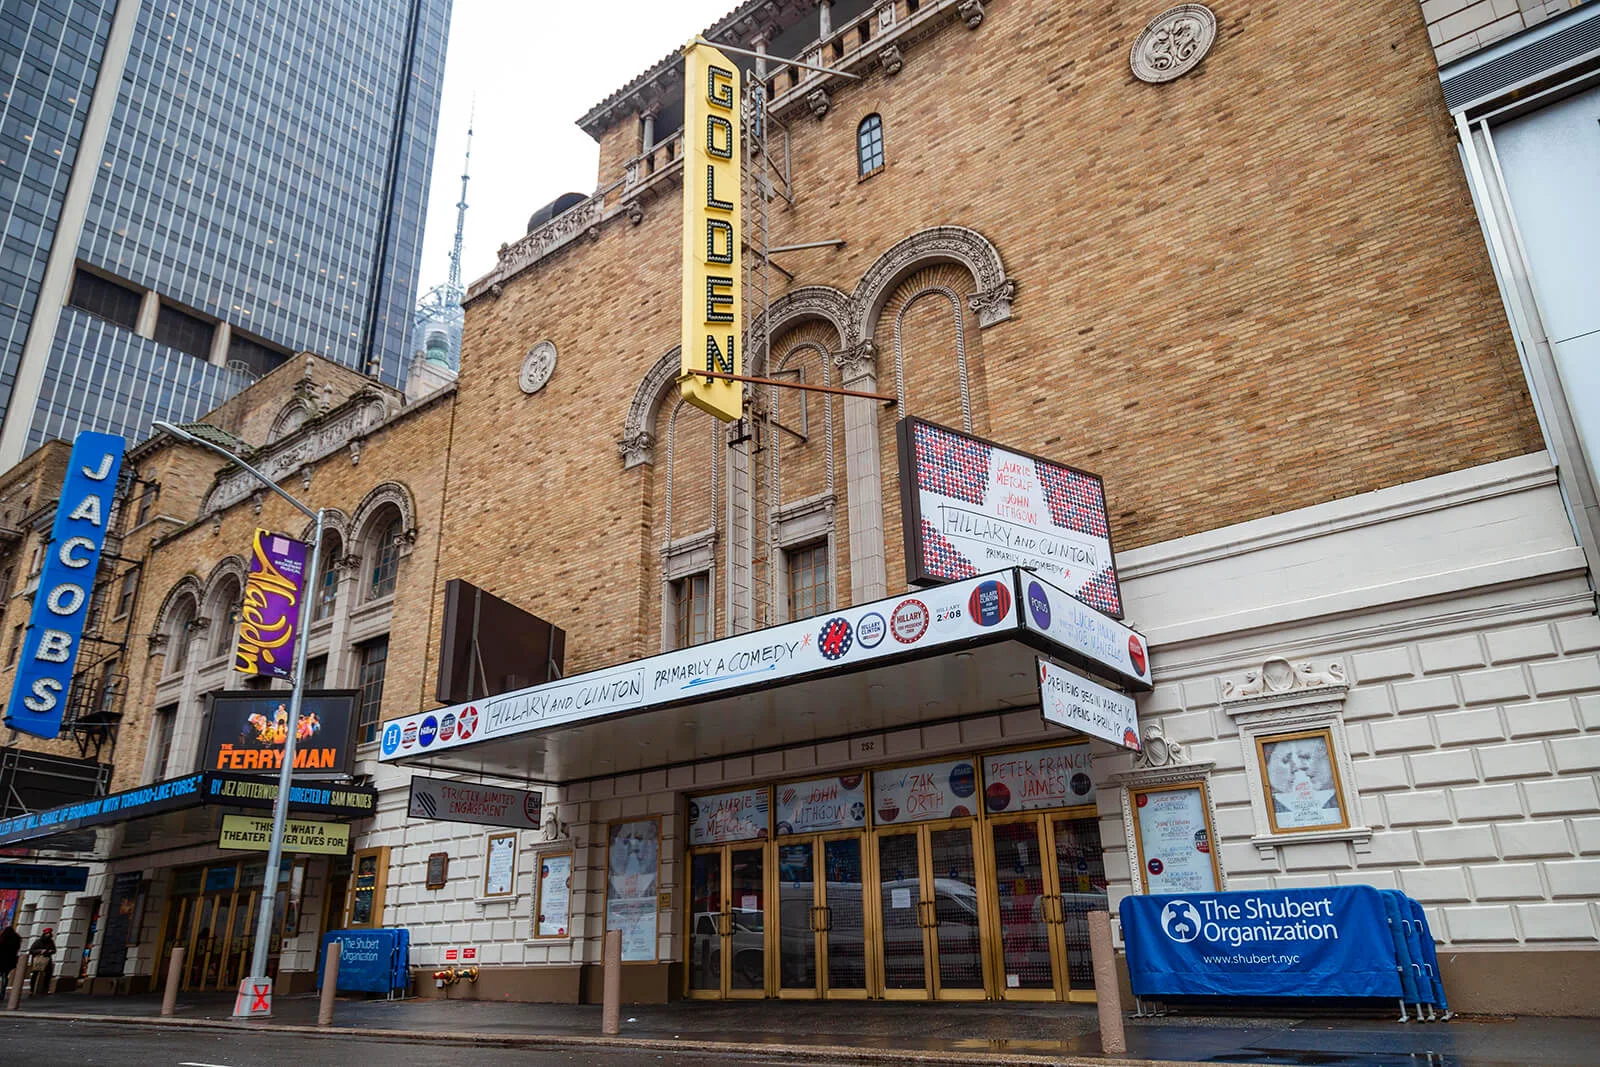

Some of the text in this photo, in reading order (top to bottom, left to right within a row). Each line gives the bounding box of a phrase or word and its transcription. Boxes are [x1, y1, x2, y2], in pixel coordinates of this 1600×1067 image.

[704, 65, 735, 385] GOLDEN
[997, 461, 1031, 477] LAURIE
[996, 472, 1033, 492] METCALF
[1006, 491, 1029, 507] JOHN
[996, 503, 1037, 525] LITHGOW
[948, 512, 1095, 566] HILLARY AND CLINTON
[986, 548, 1064, 576] PRIMARILY A COMEDY
[23, 453, 115, 713] JACOBS
[234, 527, 298, 674] Aladdin
[896, 610, 922, 624] HILLARY
[490, 693, 551, 729] HILLARY
[551, 695, 573, 712] AND
[575, 672, 641, 709] CLINTON
[653, 658, 713, 691] PRIMARILY
[714, 662, 726, 676] A
[728, 641, 799, 672] COMEDY
[1066, 703, 1092, 722] OPENS
[386, 729, 397, 746] H
[216, 748, 337, 770] FERRYMAN
[991, 758, 1033, 779] PETER
[909, 772, 937, 792] ZAK
[1019, 775, 1066, 798] JAMES
[120, 784, 171, 809] TORNADO-LIKE
[210, 779, 222, 795] BY
[221, 781, 236, 796] JEZ
[289, 787, 321, 803] DIRECTED
[321, 790, 332, 805] BY
[331, 791, 346, 806] SAM
[346, 792, 373, 808] MENDES
[441, 785, 516, 806] STRICTLY LIMITED
[808, 784, 838, 805] JOHN
[906, 792, 944, 813] ORTH
[449, 801, 508, 817] ENGAGEMENT
[708, 795, 752, 820] LAURIE
[794, 801, 848, 824] LITHGOW
[223, 831, 266, 843] THEATER
[300, 834, 325, 846] LIVES
[291, 824, 316, 835] WHAT
[317, 826, 324, 836] A
[1200, 896, 1334, 921] The Shubert
[344, 936, 380, 950] The Shubert
[1203, 920, 1338, 947] Organization
[342, 949, 378, 964] Organization
[1203, 953, 1300, 966] www.shubert.nyc
